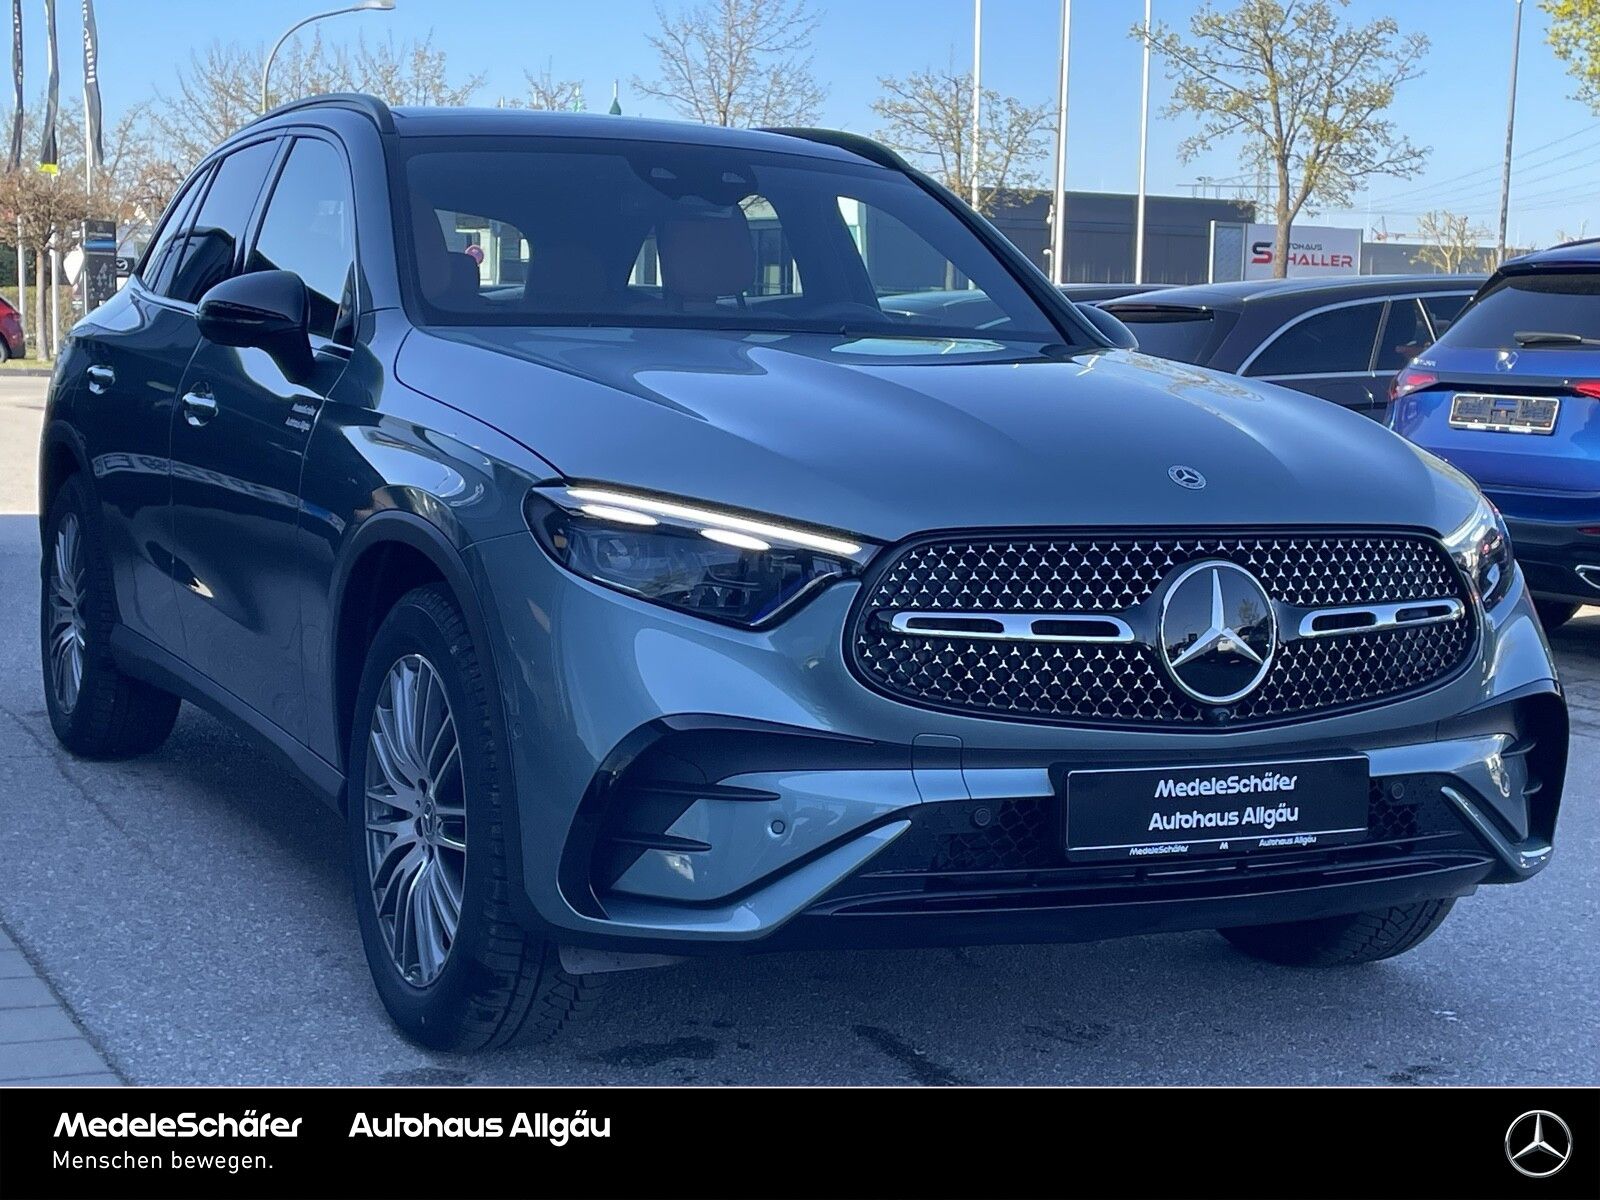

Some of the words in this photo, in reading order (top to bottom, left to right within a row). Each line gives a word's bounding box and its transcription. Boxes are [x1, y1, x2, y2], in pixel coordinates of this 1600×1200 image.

[1252, 241, 1353, 268] SHALLER
[1154, 772, 1298, 798] MedeleSchäfer
[1148, 809, 1239, 831] Autohaus
[1241, 802, 1299, 830] Allgäu
[1129, 844, 1190, 856] MedeleSchäfer
